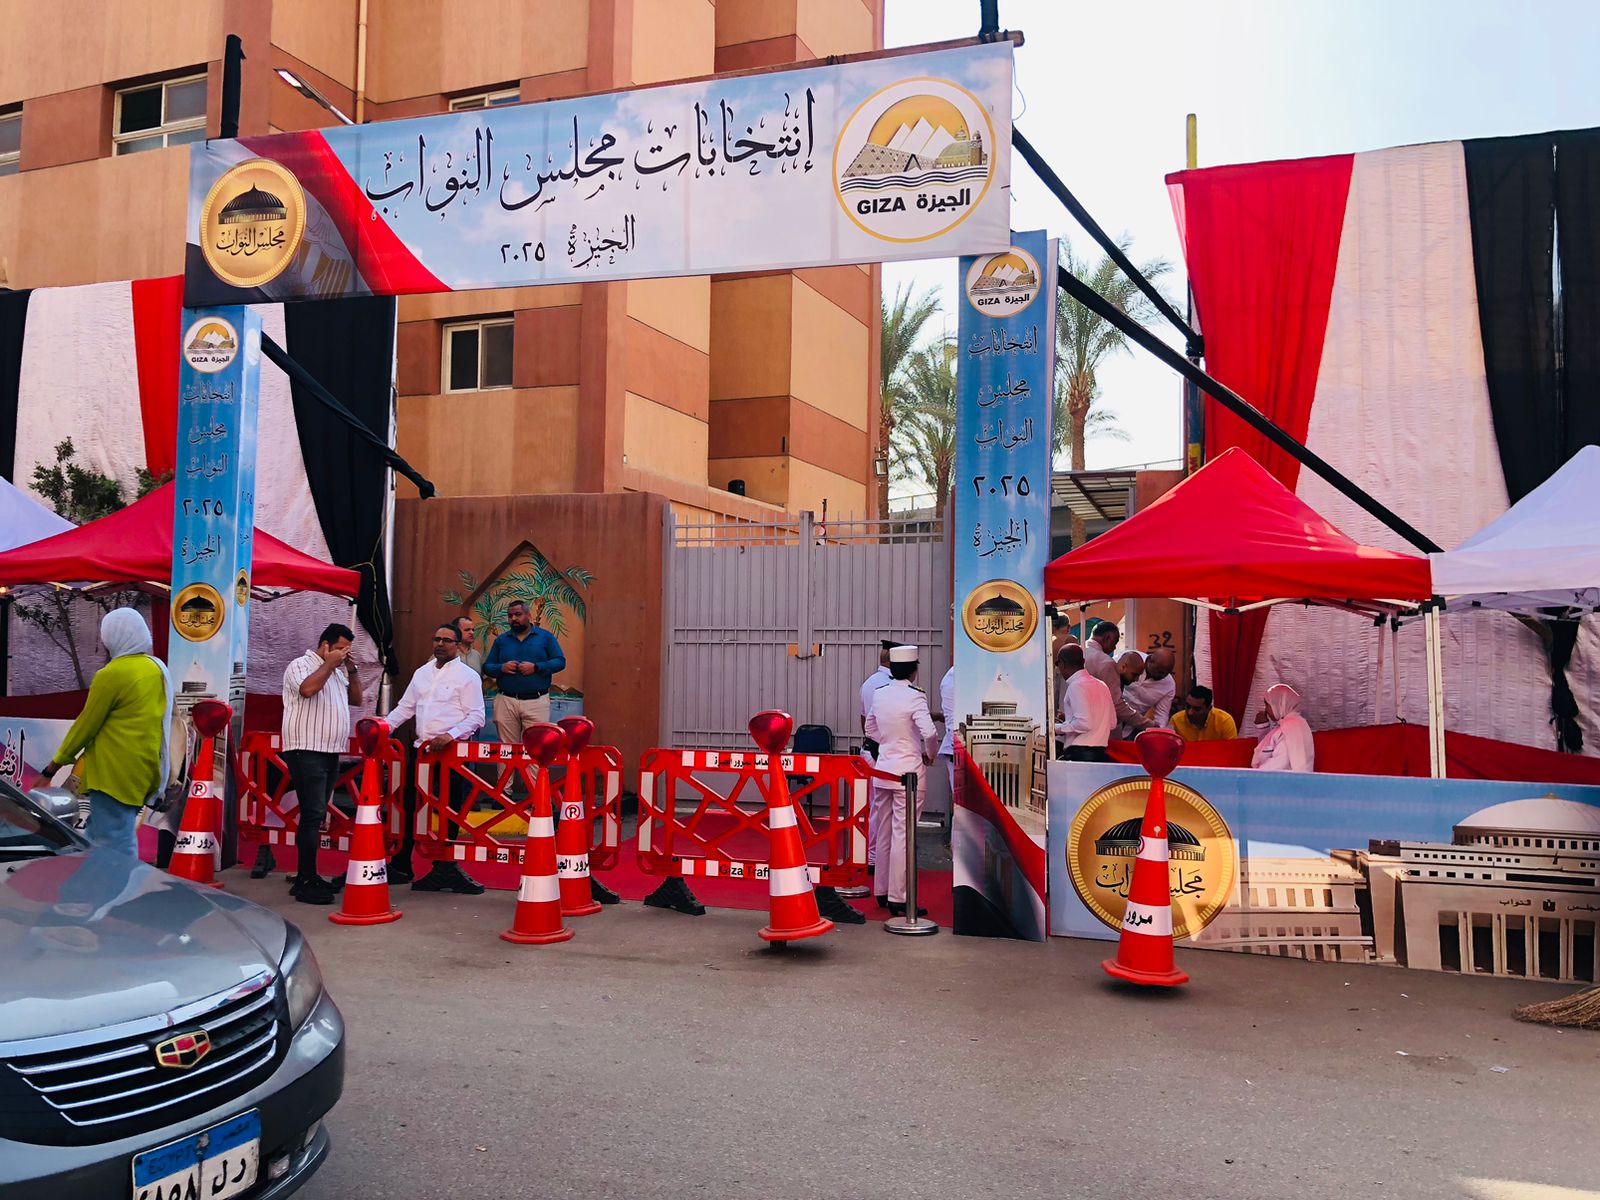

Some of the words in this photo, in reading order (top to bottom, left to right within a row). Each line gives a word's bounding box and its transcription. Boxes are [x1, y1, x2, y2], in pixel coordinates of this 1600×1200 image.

[366, 126, 494, 221] النواب
[500, 115, 625, 213] مجلس
[857, 196, 906, 215] GIZA
[916, 188, 971, 213] الجيزة
[244, 226, 285, 256] مجلس
[567, 214, 635, 269] الجيزة
[977, 297, 1000, 306] GIZA
[1005, 293, 1030, 305] الجيزة
[978, 371, 1031, 407] مجلس
[973, 518, 1029, 557] الجيزة
[719, 863, 744, 876] Giza
[1125, 909, 1153, 926] مرور
